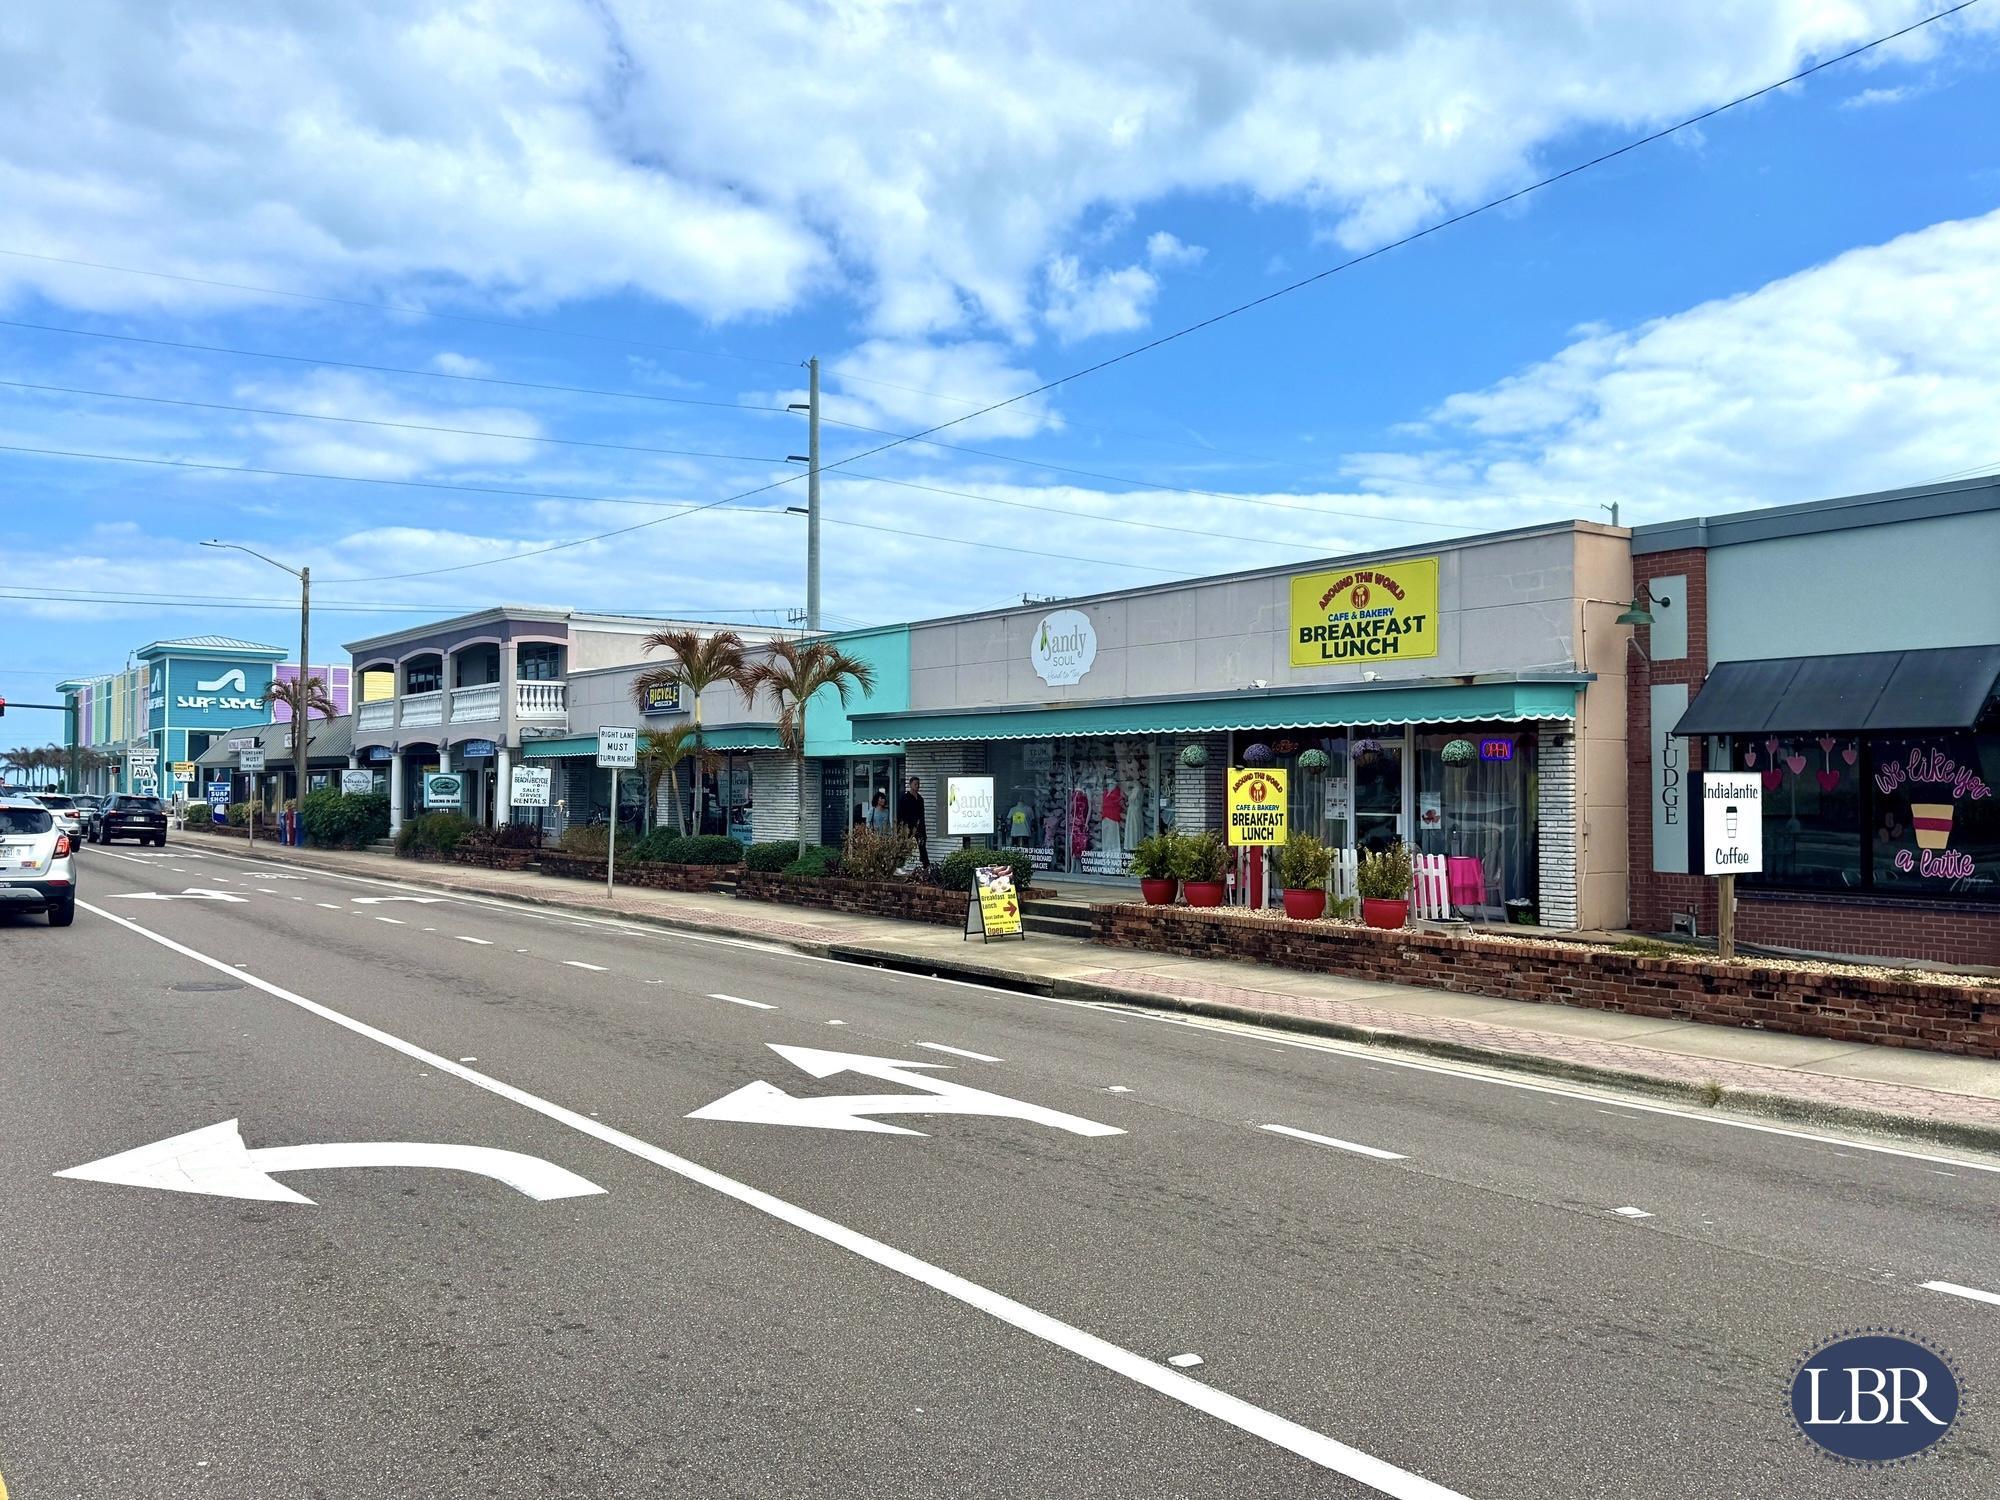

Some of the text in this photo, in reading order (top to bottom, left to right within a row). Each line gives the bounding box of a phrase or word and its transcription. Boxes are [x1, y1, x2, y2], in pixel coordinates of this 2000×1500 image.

[1319, 572, 1406, 611] AROUND THE WORLD
[1328, 607, 1394, 622] CAFE & BAKERY
[1299, 615, 1426, 643] BREAKFAST
[1321, 637, 1399, 659] LUNCH
[1053, 656, 1075, 667] SOUL
[177, 696, 217, 708] SURF
[219, 697, 263, 710] STYLE
[650, 687, 678, 704] BICYCLE
[601, 730, 619, 739] RIGHT
[607, 742, 628, 751] MUST
[1483, 742, 1509, 758] OPEN
[1906, 747, 1955, 782] like
[135, 769, 150, 777] A1A
[1662, 731, 1679, 825] FUDGE
[1233, 772, 1283, 793] AROUND THE WORLD
[1703, 782, 1758, 799] Indialantic
[1232, 813, 1284, 826] BREAKFAST
[1242, 827, 1274, 840] LUNCH
[1715, 847, 1749, 864] Coffee
[1894, 848, 1975, 878] a latte
[981, 894, 1005, 902] Breakfast
[988, 927, 1003, 935] Open
